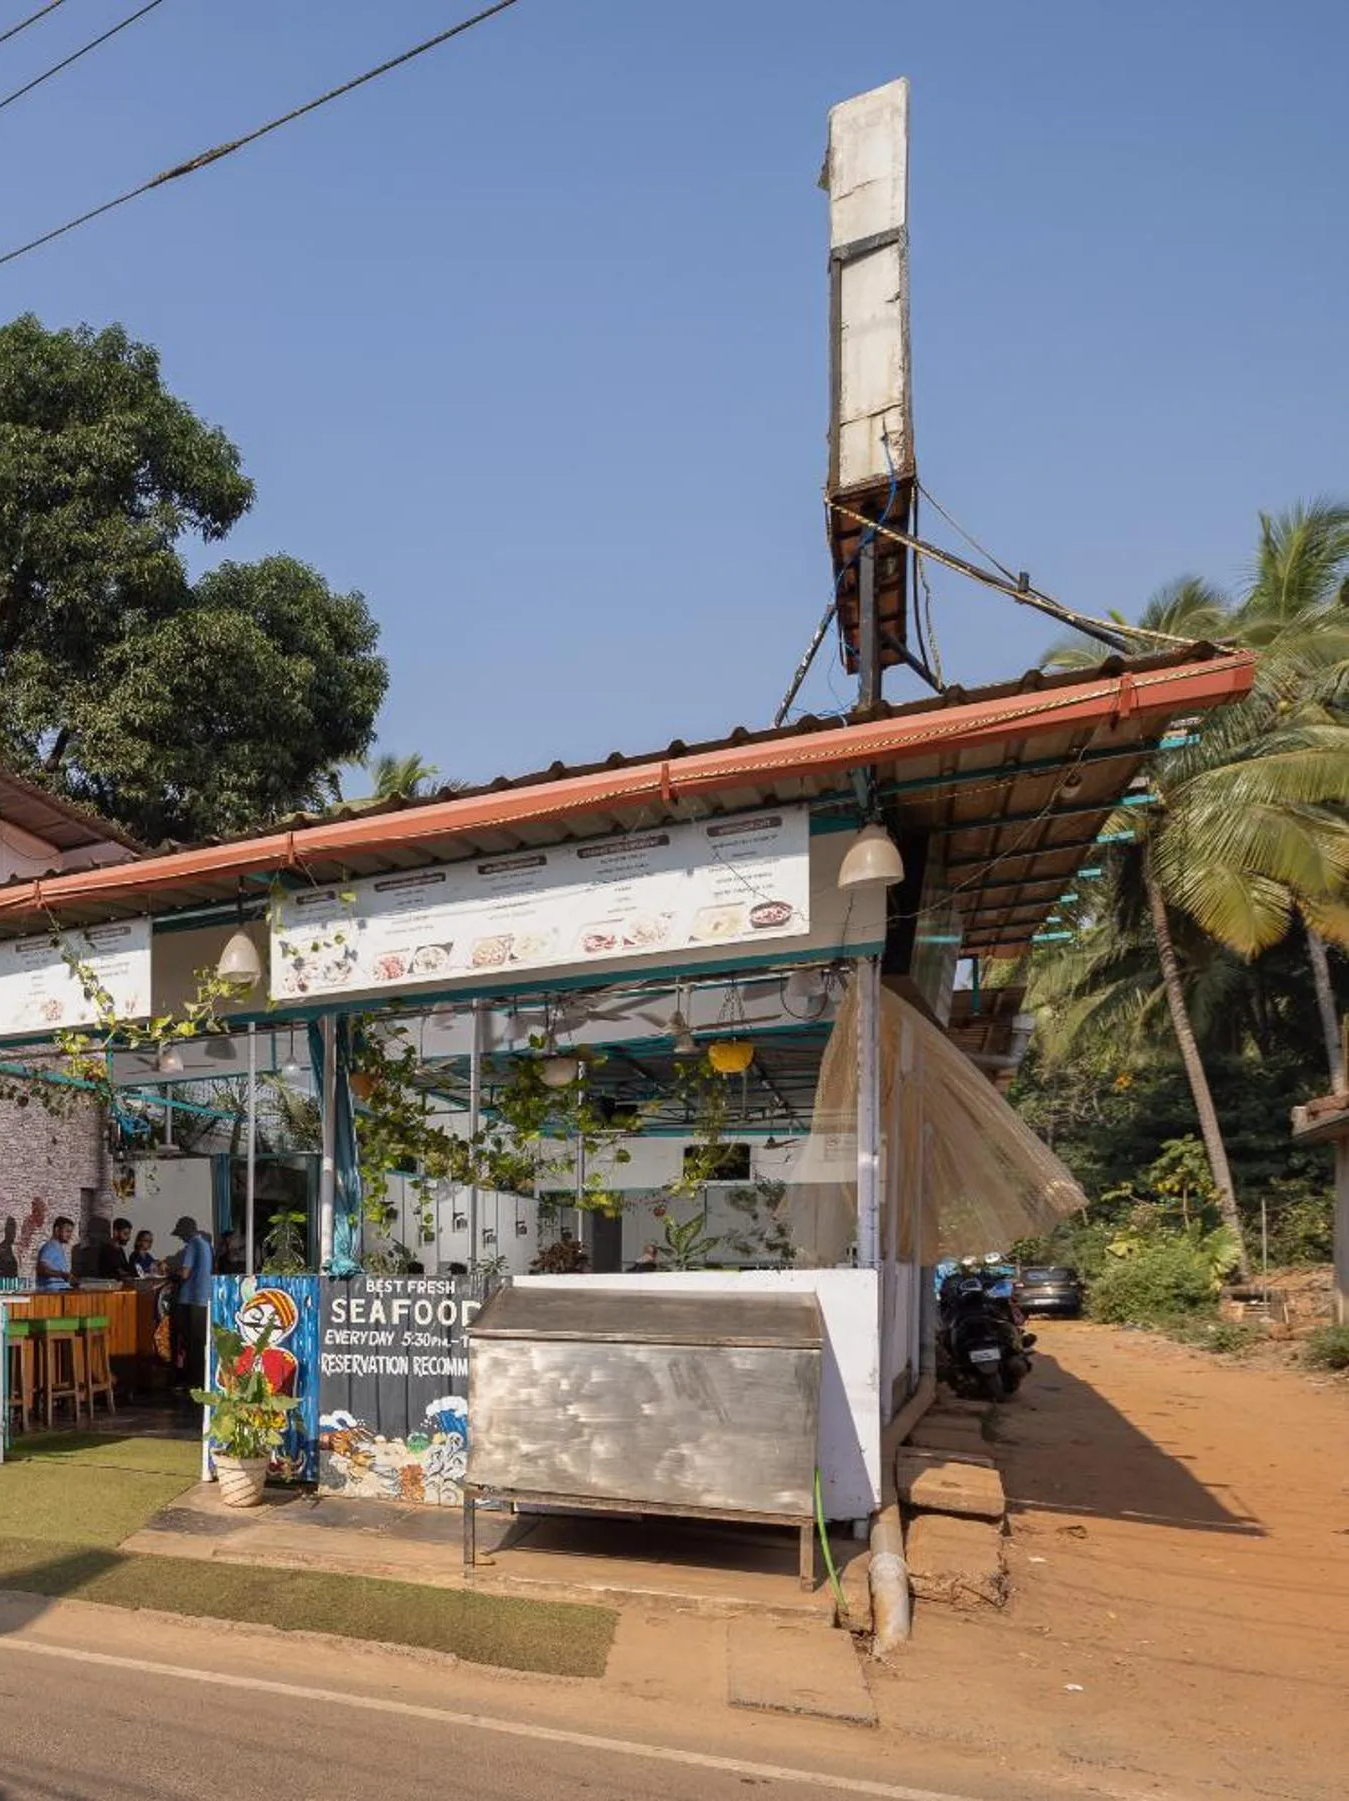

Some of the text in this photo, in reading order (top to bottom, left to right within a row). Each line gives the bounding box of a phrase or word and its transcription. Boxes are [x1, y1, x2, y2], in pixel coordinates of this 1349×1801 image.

[366, 1280, 456, 1295] BEST FRESH
[331, 1298, 482, 1327] SEAFOOD
[324, 1329, 395, 1347] EVERYDAY
[321, 1352, 468, 1377] RESERVATION RECOMM
